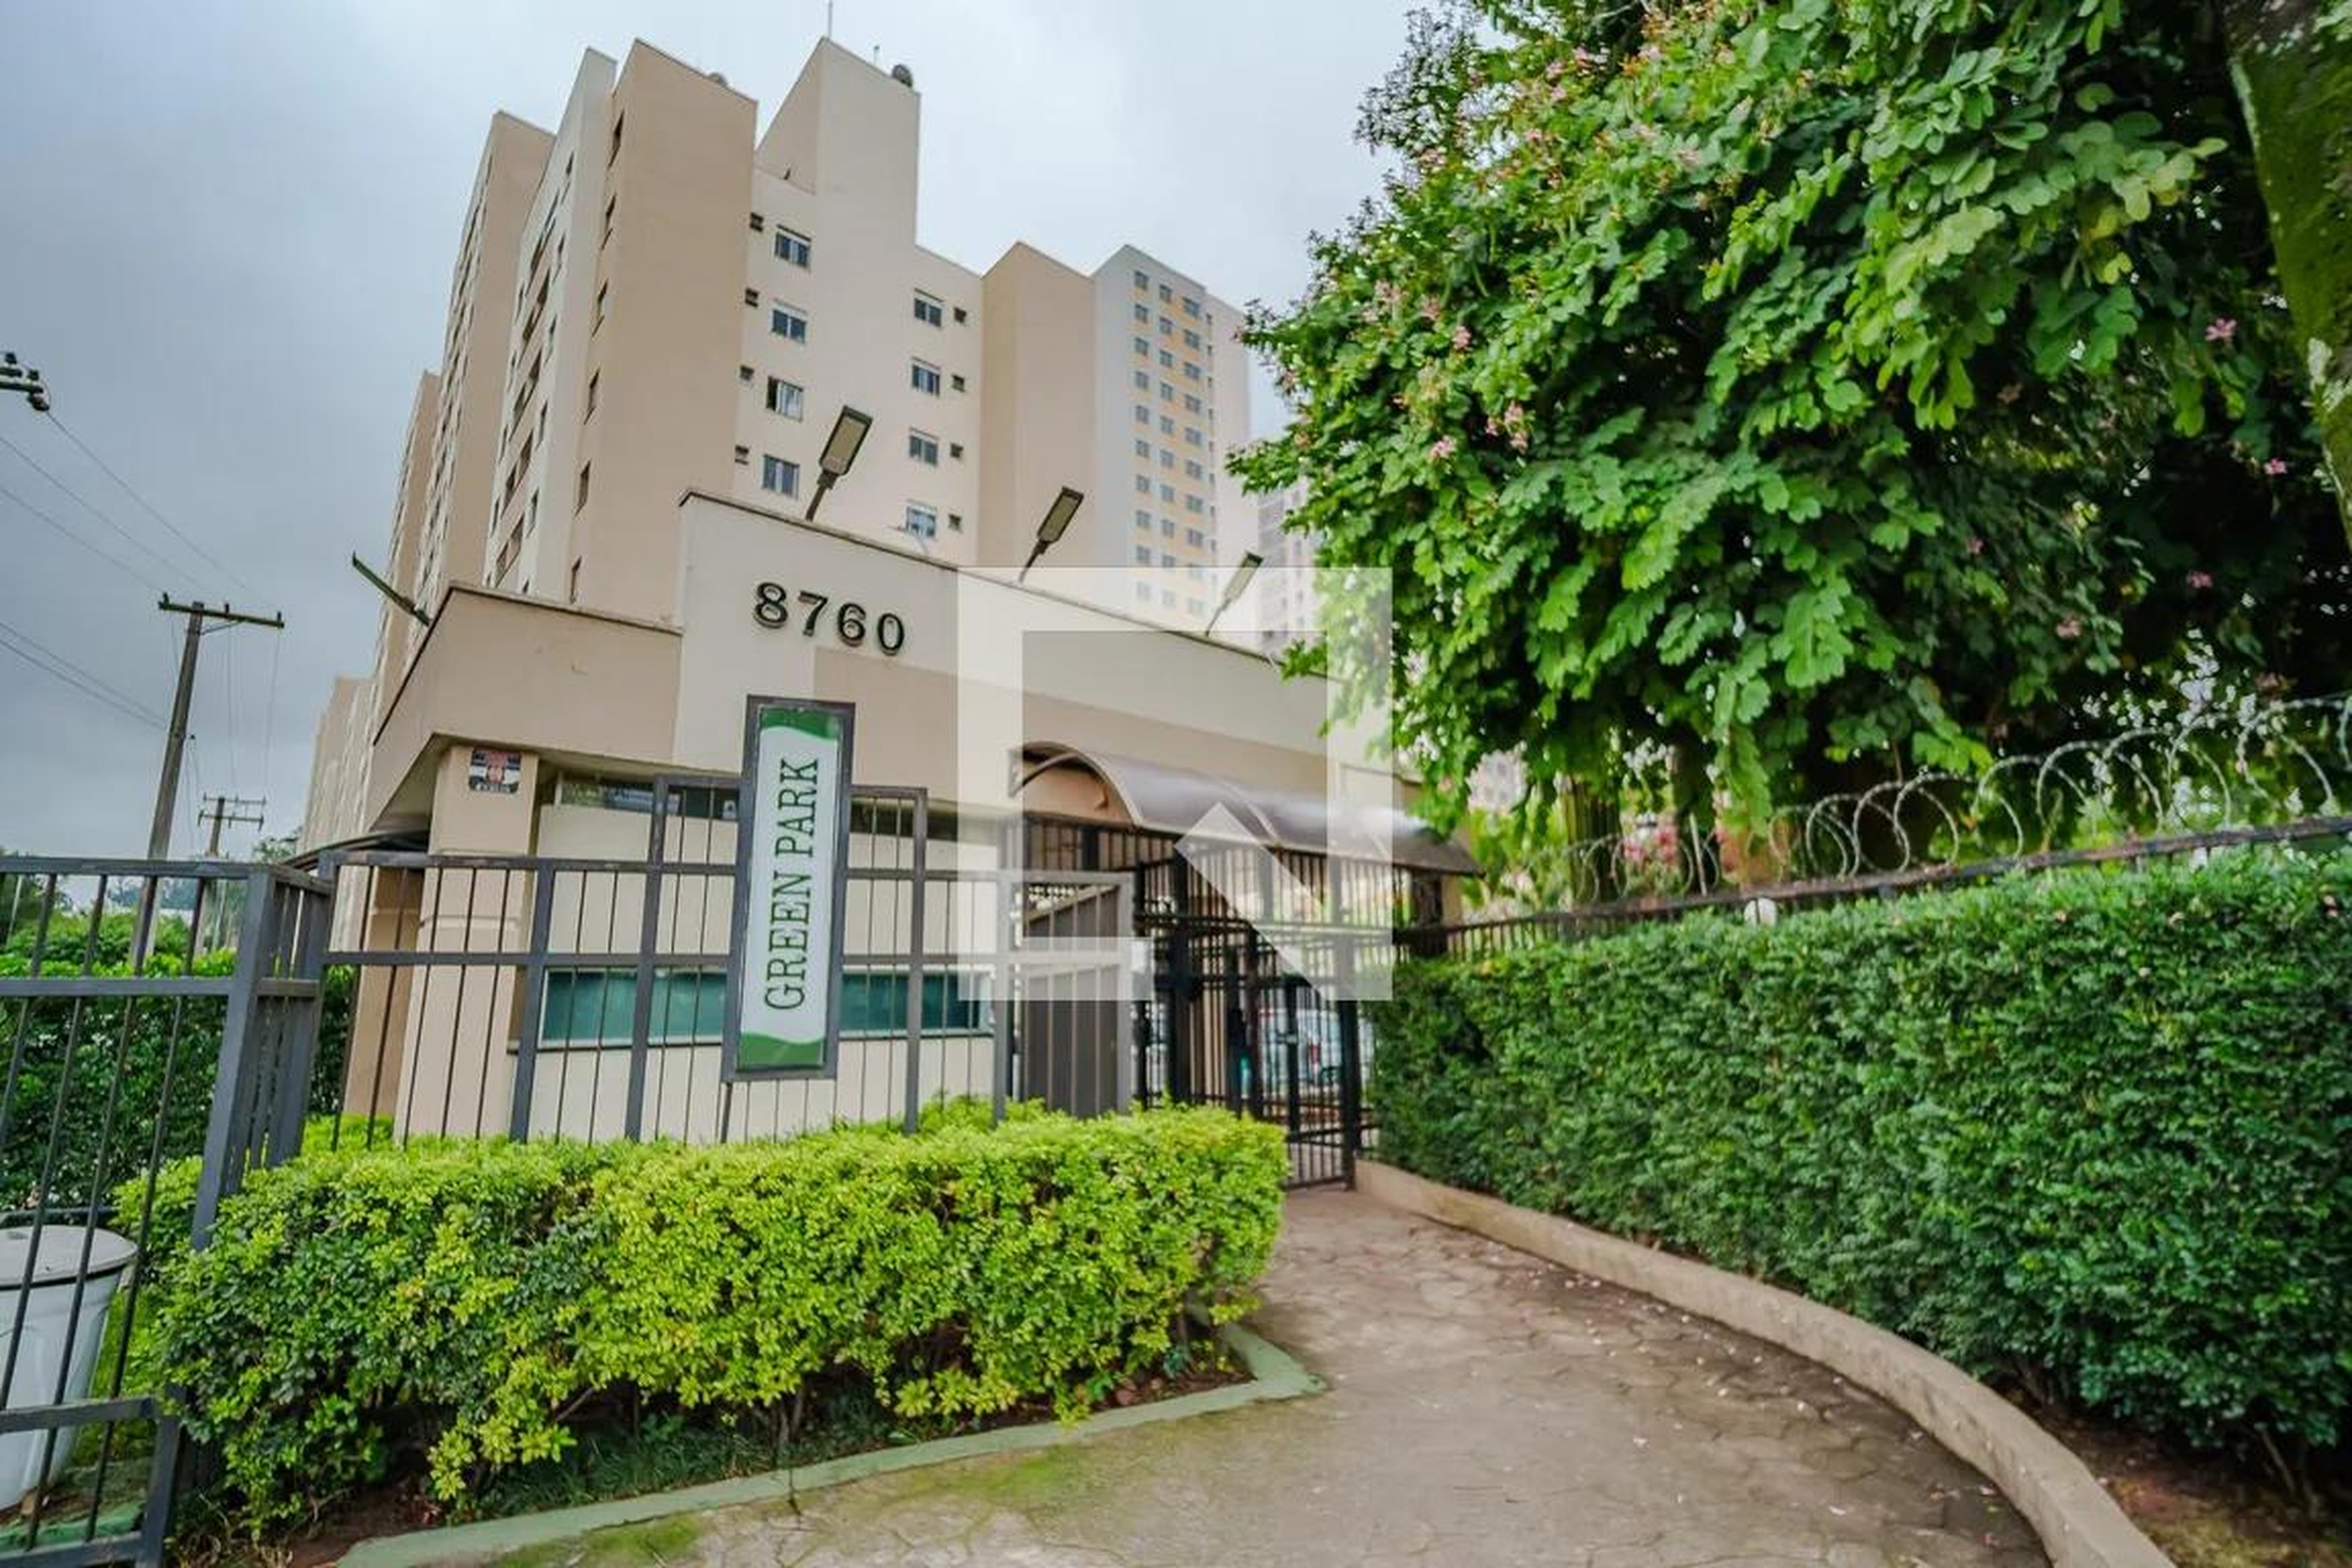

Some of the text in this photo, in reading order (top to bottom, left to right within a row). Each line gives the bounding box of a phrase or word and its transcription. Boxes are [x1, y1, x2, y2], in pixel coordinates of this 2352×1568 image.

[753, 582, 905, 656] 8760
[764, 758, 819, 1011] GREEN PARK
